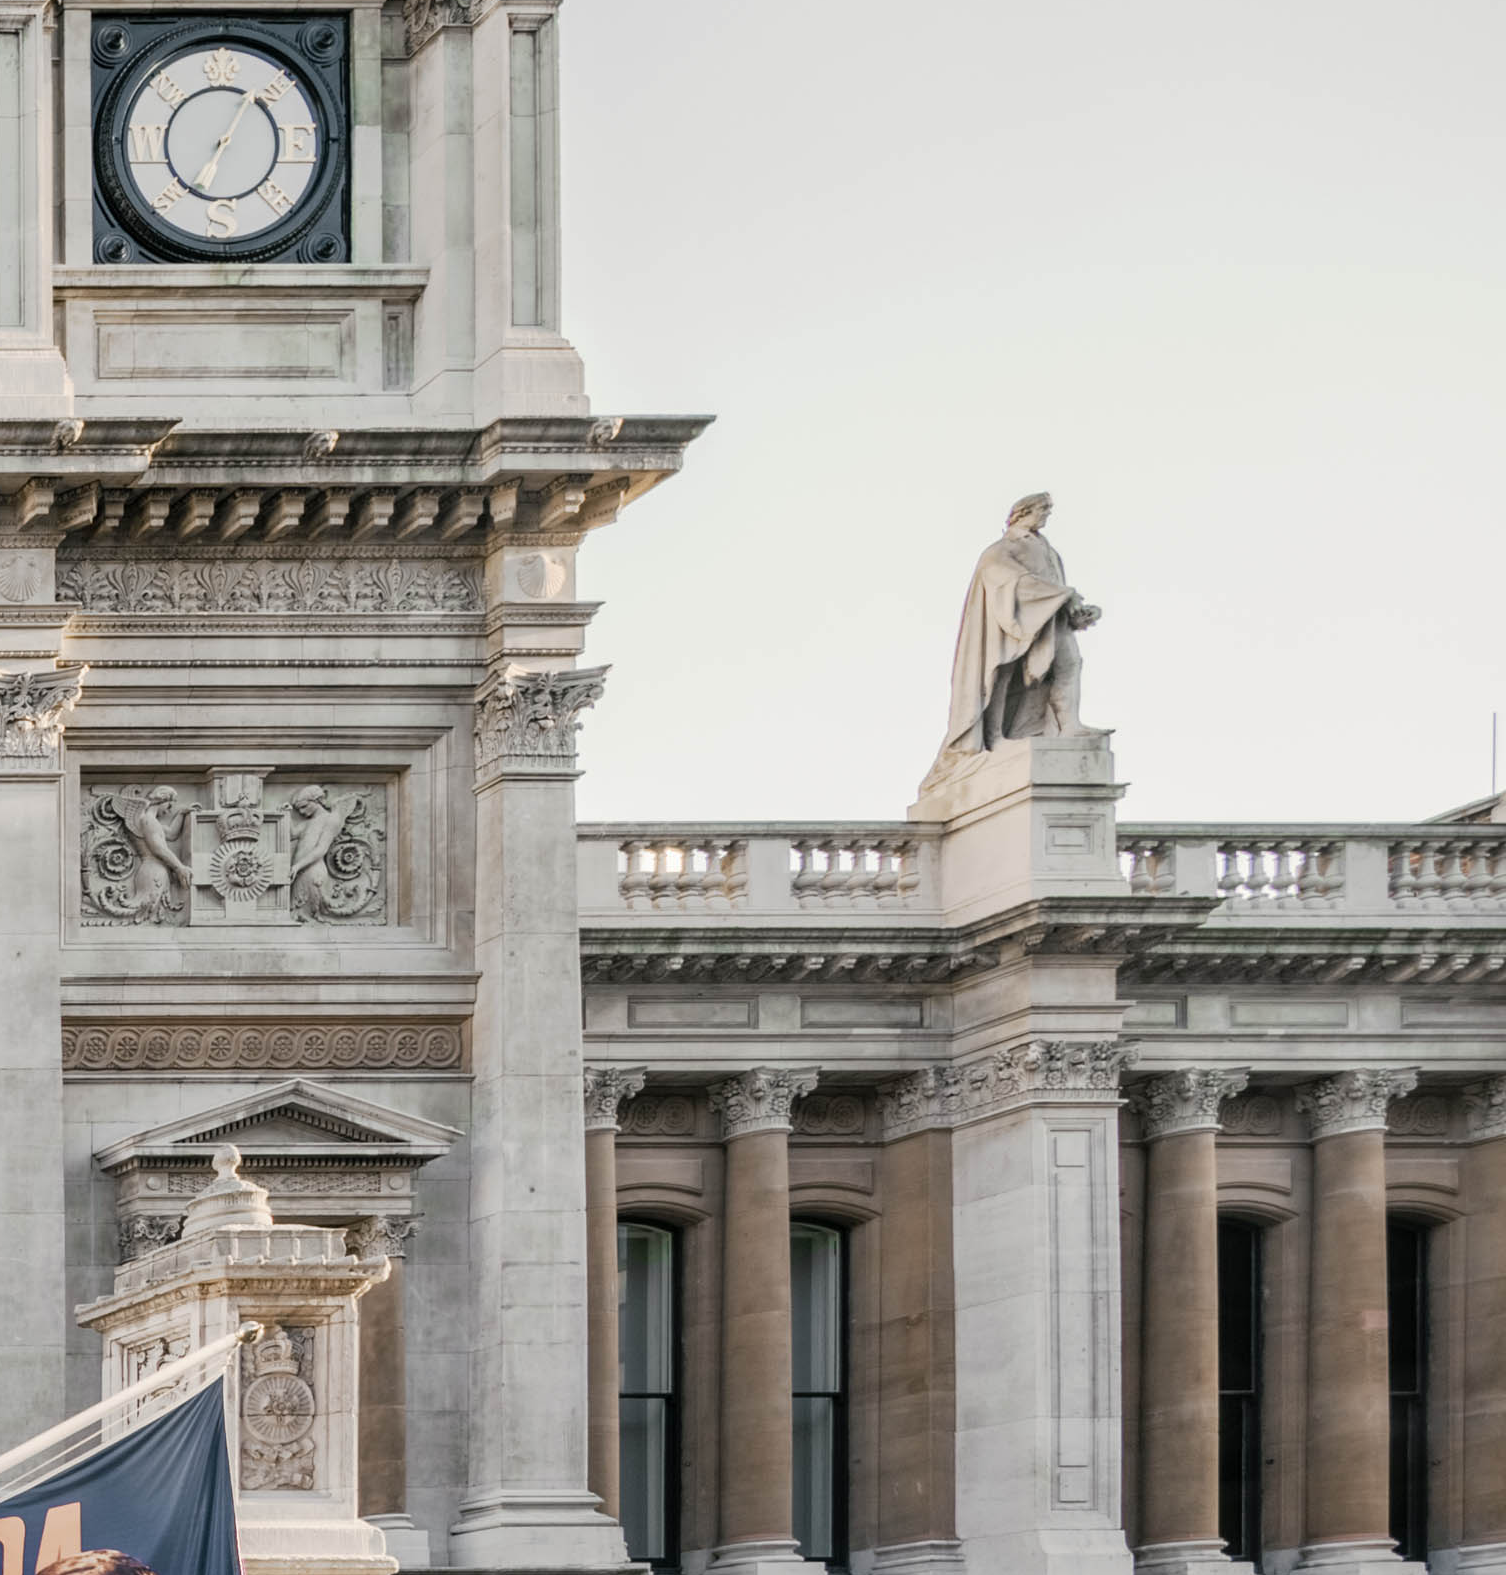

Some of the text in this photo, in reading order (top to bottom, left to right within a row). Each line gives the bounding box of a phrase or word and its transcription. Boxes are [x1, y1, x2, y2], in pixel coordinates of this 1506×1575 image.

[149, 70, 189, 110] NW
[257, 70, 296, 109] NE
[128, 125, 169, 163] W
[277, 123, 316, 163] E
[151, 177, 190, 216] SW
[257, 176, 295, 216] SE
[206, 198, 238, 238] S
